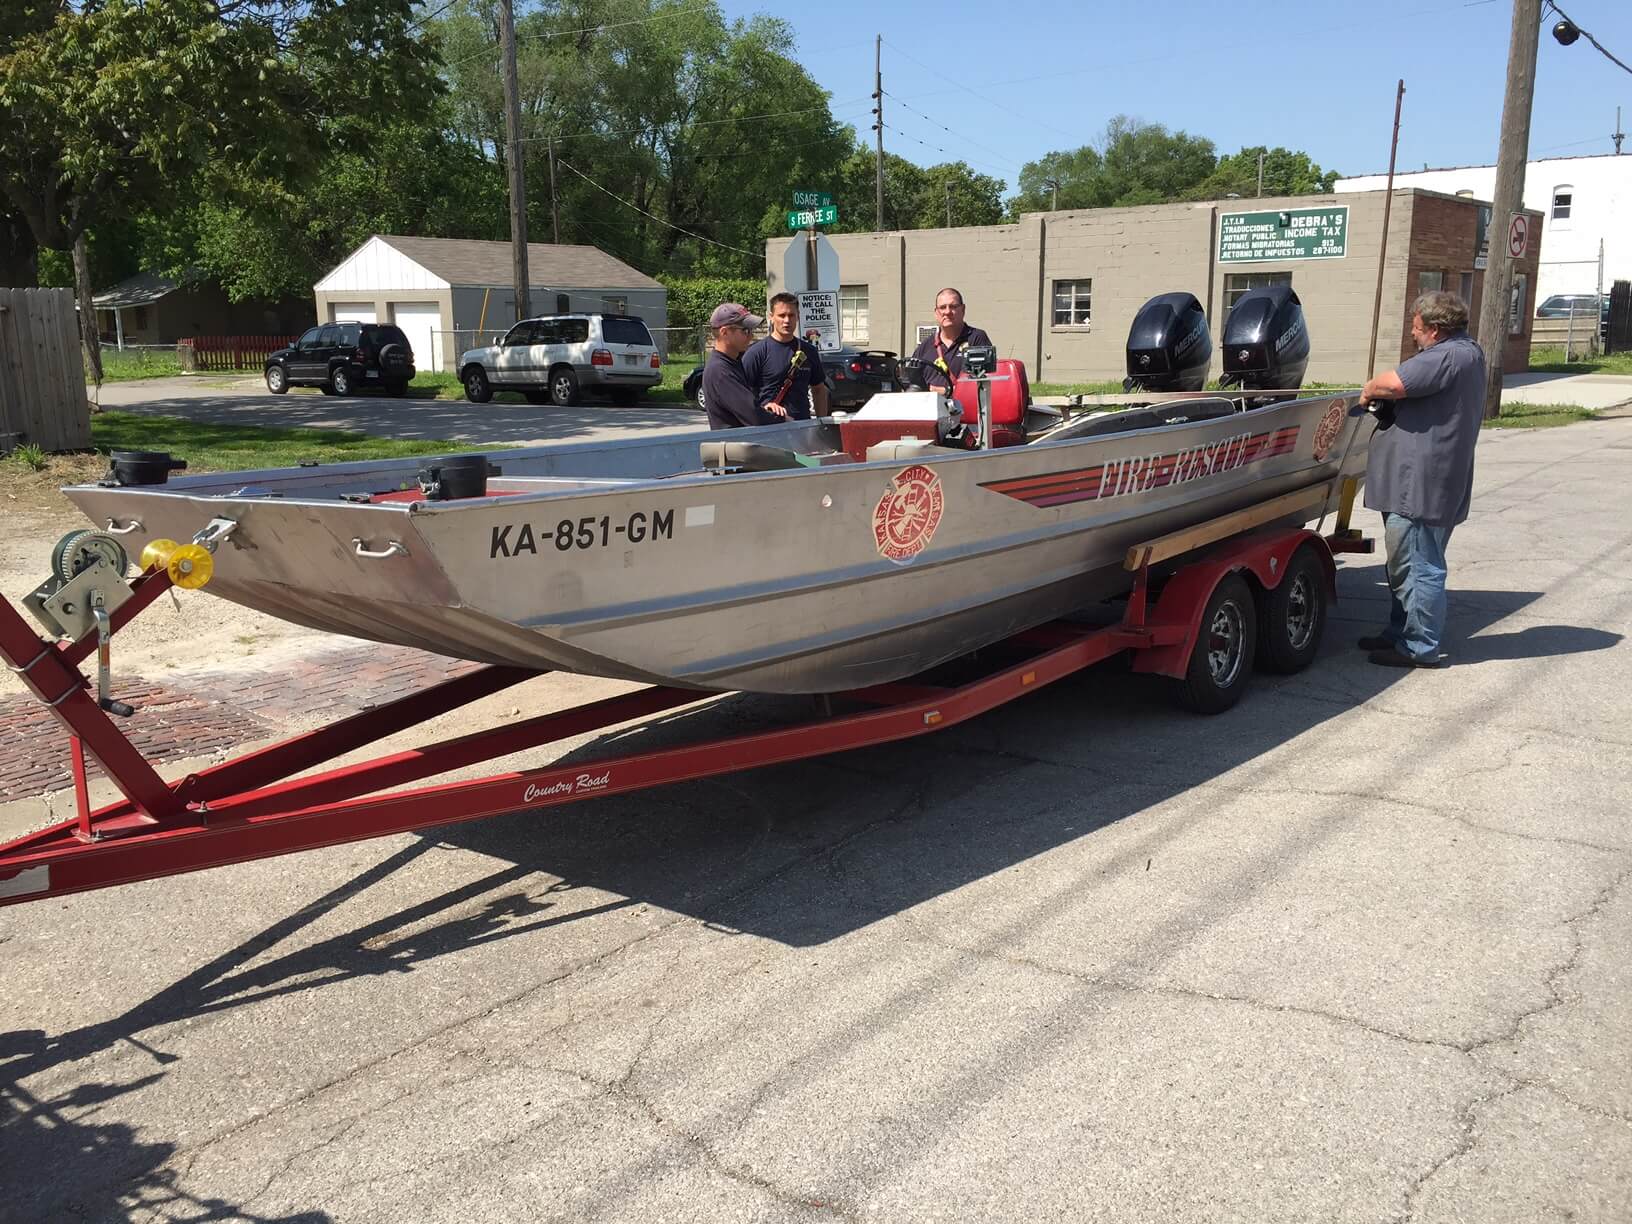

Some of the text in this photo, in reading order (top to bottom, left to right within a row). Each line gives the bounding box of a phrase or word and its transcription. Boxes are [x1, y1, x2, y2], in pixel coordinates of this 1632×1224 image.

[794, 191, 831, 206] OSAGE AV
[791, 216, 796, 226] S
[826, 210, 833, 221] ST
[1291, 215, 1342, 227] DEBRA'S
[1251, 232, 1277, 240] PUBLIC
[1284, 226, 1341, 238] INCOME TAX
[1321, 239, 1335, 247] 913
[1254, 249, 1264, 257] DE
[805, 313, 832, 321] POLICE
[905, 468, 926, 482] CITY
[490, 508, 675, 559] KA-851-GM
[524, 781, 573, 802] Country
[576, 770, 610, 789] Road
